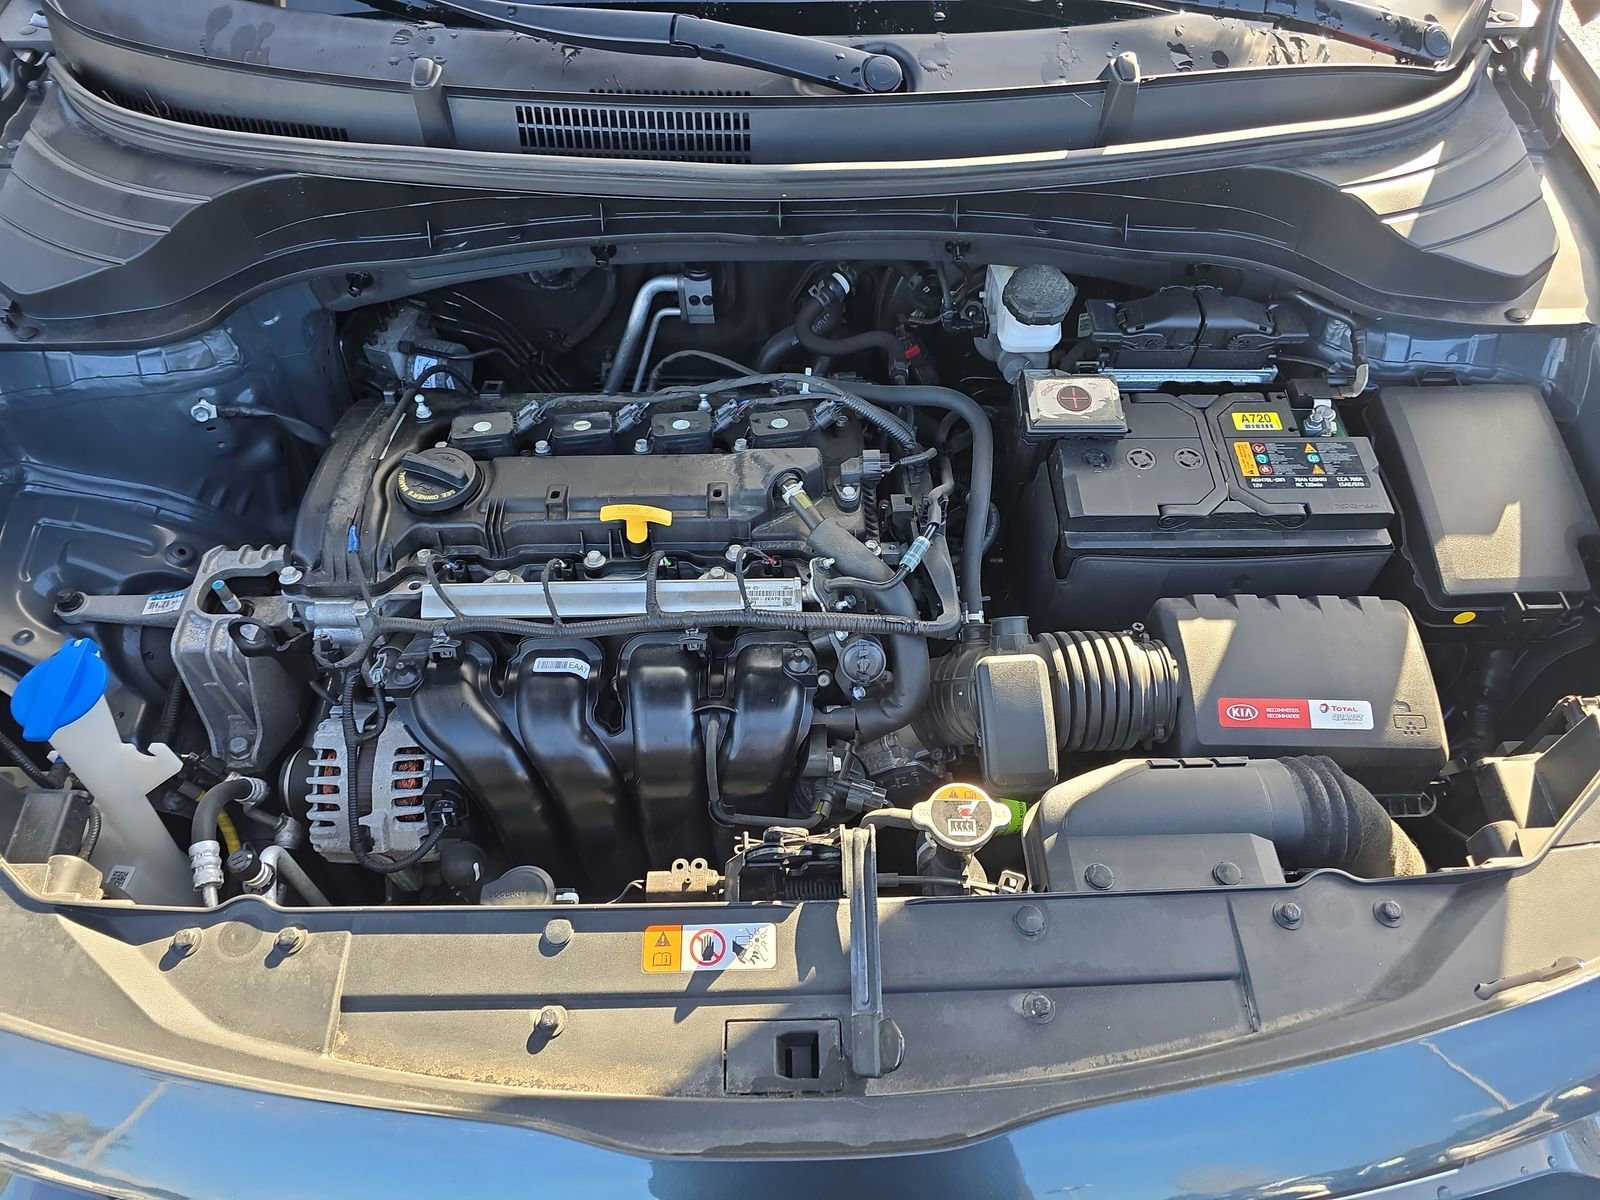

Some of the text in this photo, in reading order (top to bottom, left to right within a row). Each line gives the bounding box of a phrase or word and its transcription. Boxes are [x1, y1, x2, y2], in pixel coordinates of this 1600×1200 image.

[1241, 413, 1272, 423] A720
[407, 490, 439, 500] OWNER'S
[440, 489, 456, 498] SEE
[569, 661, 588, 674] EAA7
[1231, 707, 1253, 718] KIA
[1331, 713, 1364, 722] QUARTZ
